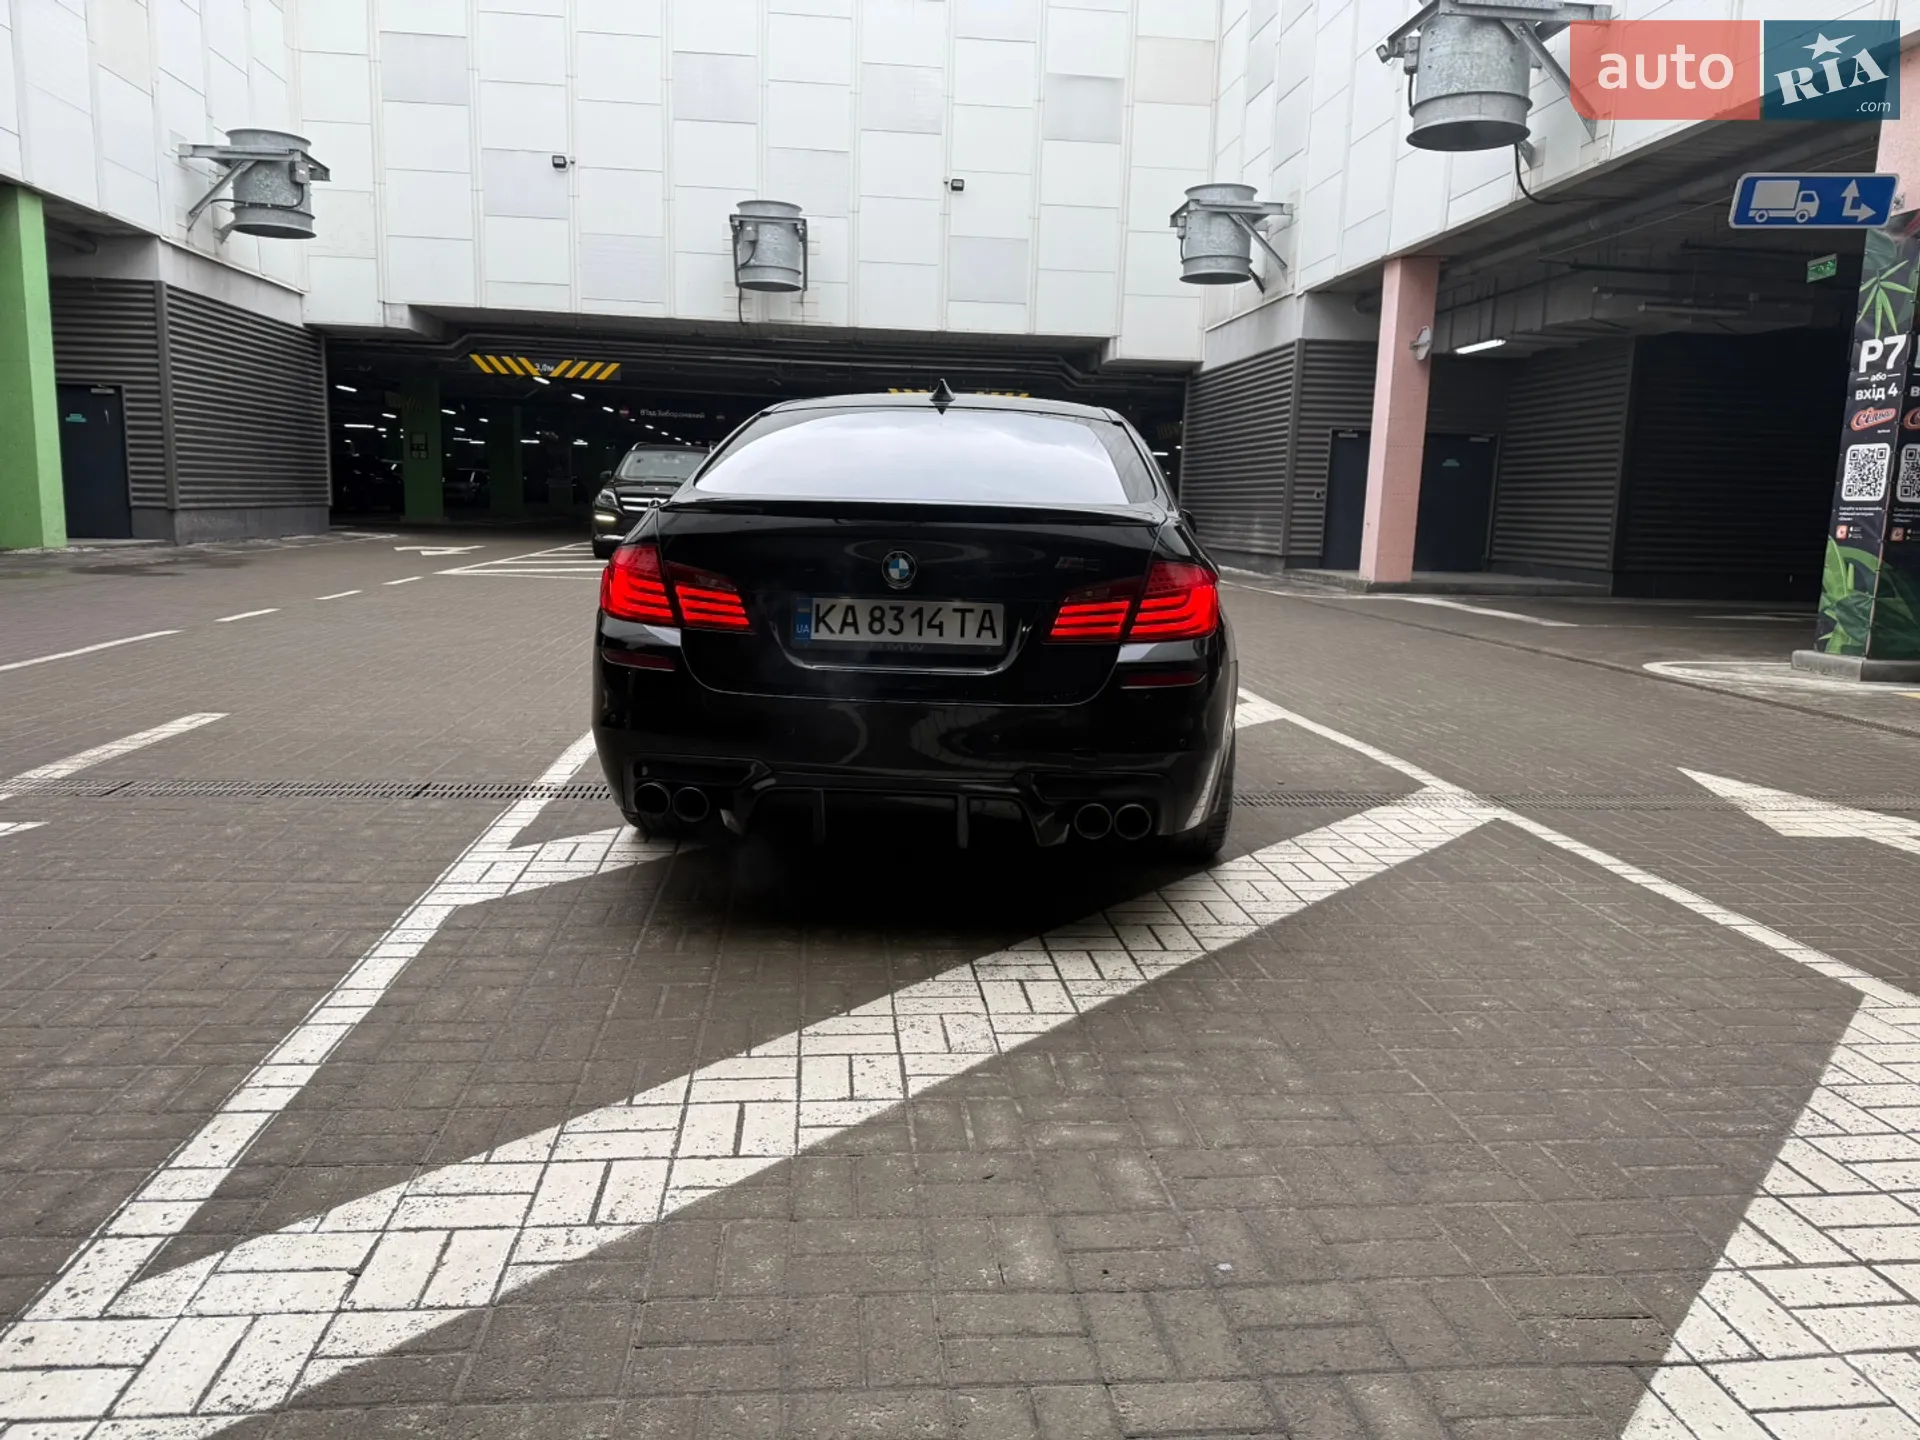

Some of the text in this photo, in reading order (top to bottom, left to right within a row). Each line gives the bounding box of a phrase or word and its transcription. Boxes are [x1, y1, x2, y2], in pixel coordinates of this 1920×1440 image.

[1859, 334, 1907, 373] P7
[1870, 372, 1887, 382] або
[1855, 384, 1886, 401] вхід
[1888, 382, 1898, 397] 4
[796, 624, 810, 634] UA
[814, 603, 998, 640] KA 8314 TA
